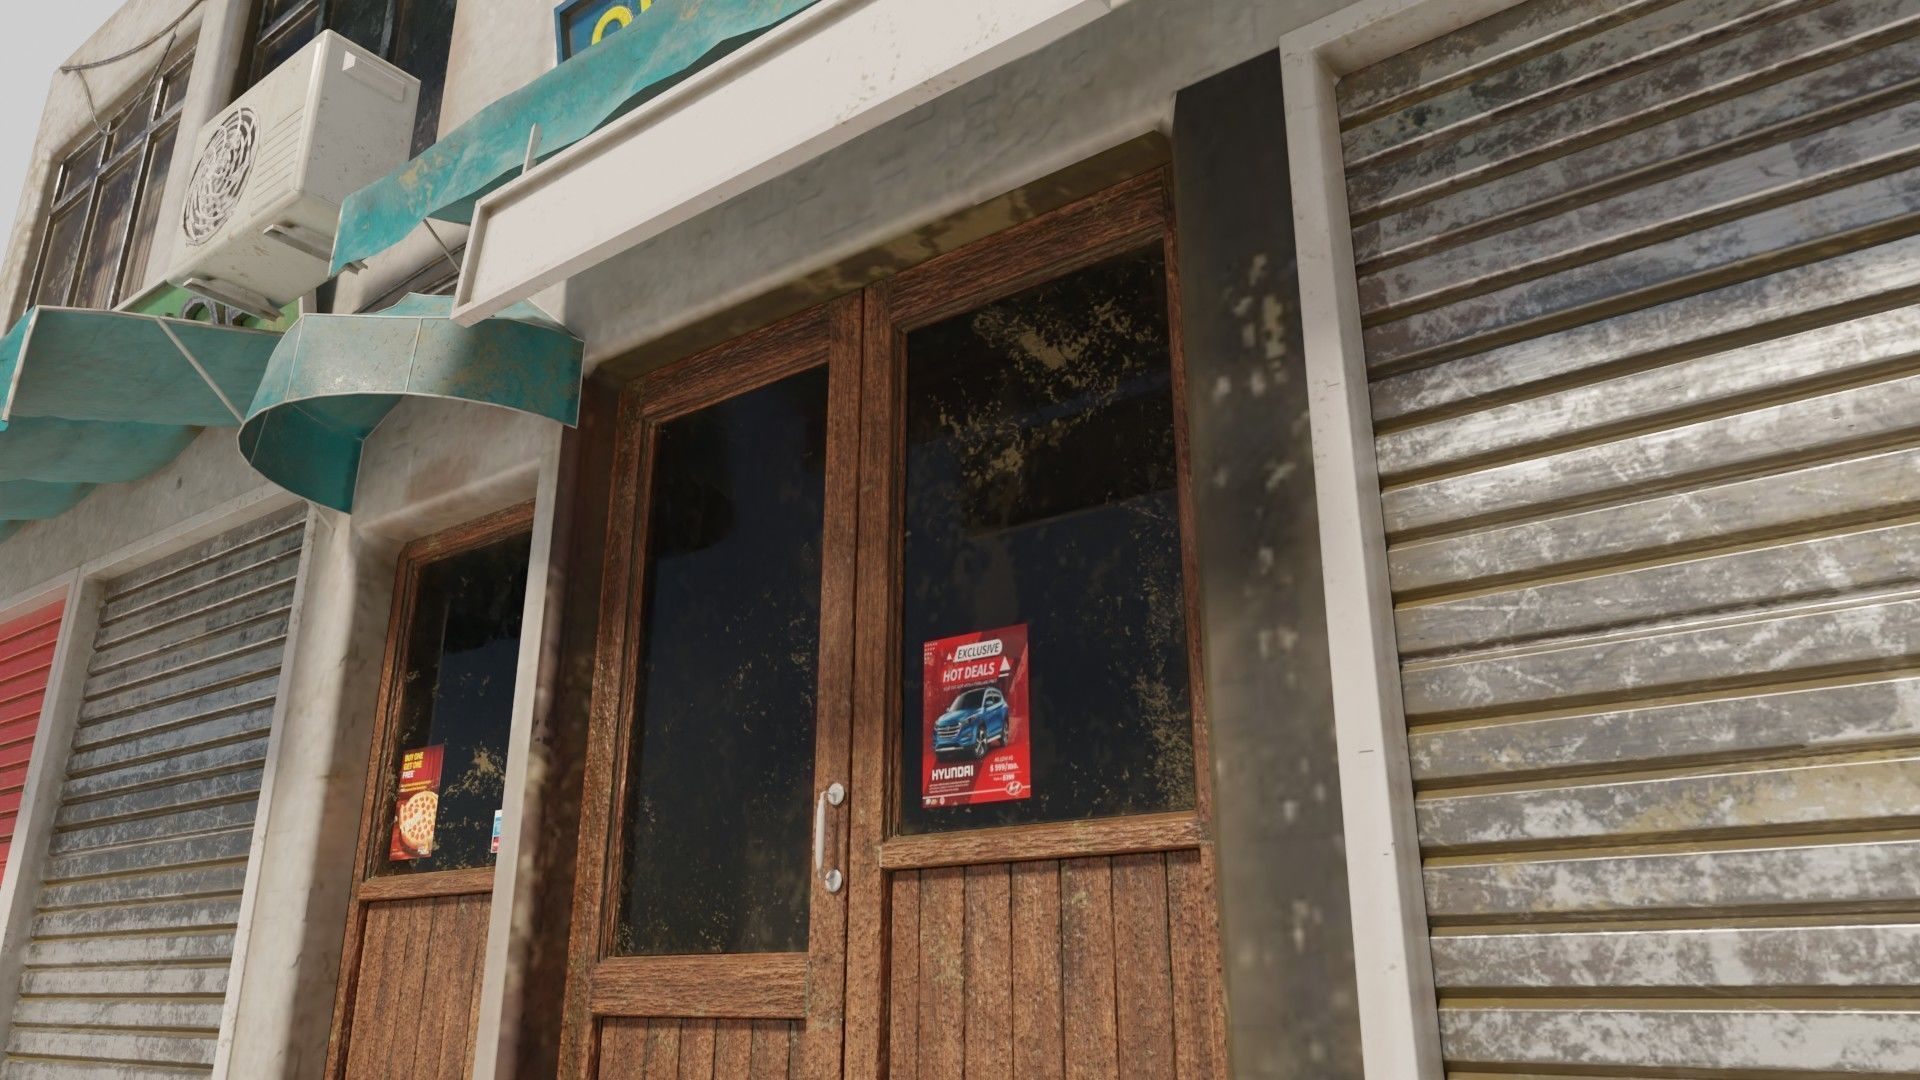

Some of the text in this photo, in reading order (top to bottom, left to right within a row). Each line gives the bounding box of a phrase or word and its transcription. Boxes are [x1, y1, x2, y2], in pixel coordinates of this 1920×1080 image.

[957, 643, 1000, 659] EXCLUSIVE
[943, 662, 995, 683] HOT DEALS
[405, 752, 424, 762] BUY ONE
[403, 760, 423, 771] GET ONE
[402, 770, 415, 779] FREE
[931, 765, 974, 780] HYUNDAI
